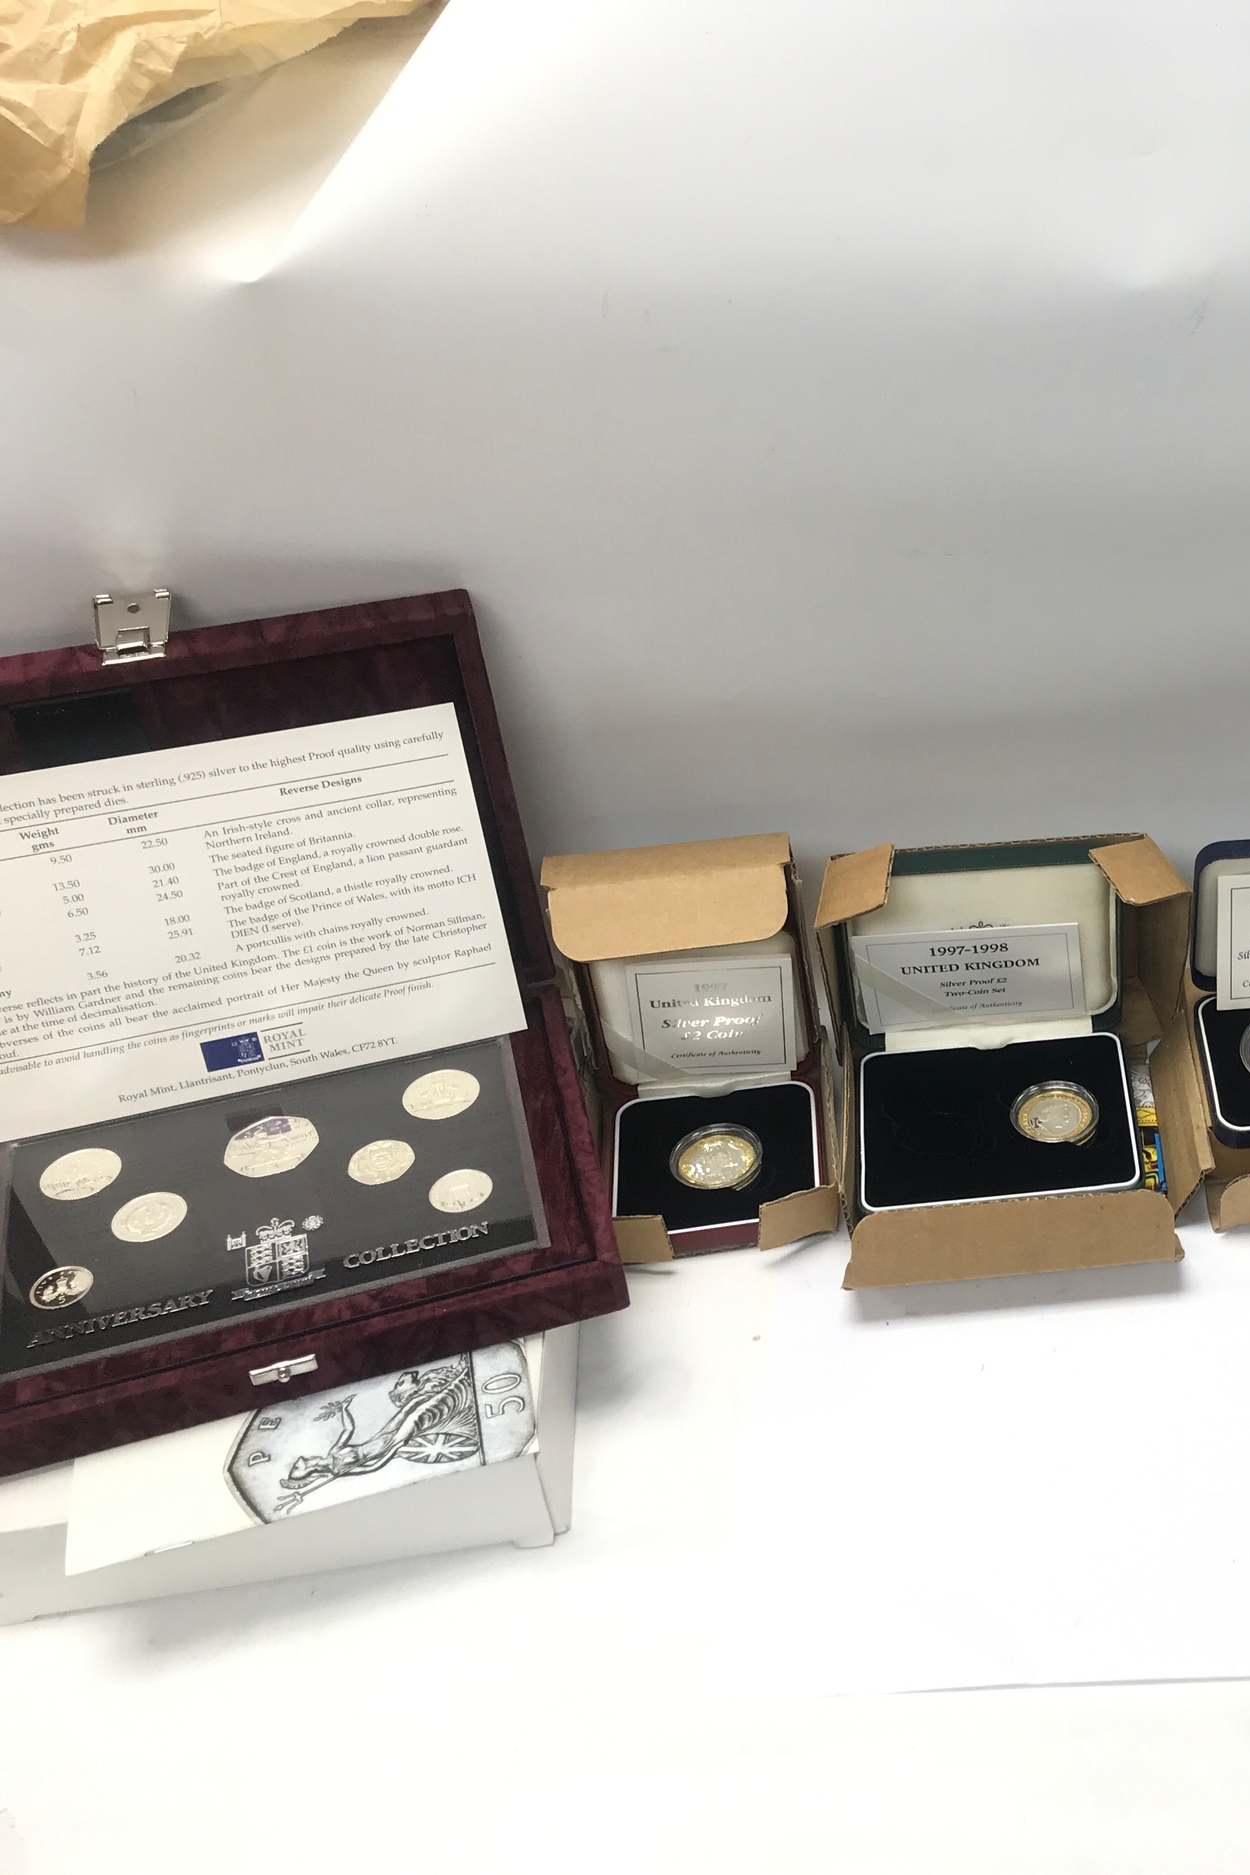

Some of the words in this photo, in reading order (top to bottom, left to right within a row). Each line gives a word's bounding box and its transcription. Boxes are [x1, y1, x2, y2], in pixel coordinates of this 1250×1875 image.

[37, 797, 58, 806] has
[57, 792, 86, 803] been
[86, 784, 121, 798] struck
[122, 783, 134, 792] in
[135, 777, 177, 790] sterling
[177, 770, 206, 784] (.925)
[208, 767, 237, 778] silver
[238, 765, 250, 773] to
[251, 761, 268, 771] the
[269, 754, 307, 768] highest
[307, 748, 335, 761] Proof
[337, 744, 372, 758] quality
[373, 739, 402, 750] using
[402, 730, 444, 745] carefully
[278, 783, 320, 797] Reverse
[320, 776, 363, 789] Designs
[3, 808, 51, 826] specially
[52, 799, 102, 819] prepared
[103, 797, 129, 807] dies.
[107, 811, 159, 826] Diameter
[203, 829, 219, 839] An
[221, 819, 273, 836] Irish-style
[275, 815, 302, 826] cross
[304, 809, 324, 821] and
[327, 803, 363, 817] ancient
[365, 798, 395, 810] collar,
[397, 787, 458, 805] representing
[18, 827, 60, 841] Weight
[125, 825, 148, 835] mm
[140, 837, 169, 850] 22.50
[204, 835, 253, 850] Northern
[254, 826, 293, 841] Ireland.
[30, 841, 56, 854] gms
[208, 853, 230, 864] The
[231, 846, 263, 860] seated
[264, 842, 295, 855] figure
[296, 837, 307, 848] of
[308, 831, 356, 846] Britannia.
[49, 853, 73, 865] 9.50
[148, 862, 176, 875] 30.00
[52, 879, 81, 892] 13.50
[152, 875, 180, 889] 21.40
[156, 889, 184, 902] 24.50
[220, 888, 255, 903] royally
[257, 878, 303, 895] crowned.
[62, 893, 85, 905] 5.00
[67, 906, 89, 919] 6.50
[164, 913, 191, 926] 18.00
[167, 927, 194, 940] 25.91
[230, 925, 259, 939] DIEN
[261, 924, 270, 934] (I
[269, 918, 304, 932] serve).
[235, 943, 244, 953] A
[245, 934, 293, 953] portcullis
[293, 929, 317, 941] with
[318, 924, 350, 936] chains
[350, 916, 384, 931] royally
[385, 907, 429, 923] crowned.
[74, 931, 97, 944] 3.25
[78, 945, 102, 957] 7.12
[929, 943, 1009, 957] 1997-1998
[174, 951, 202, 964] 20.32
[4, 1016, 14, 1024] is
[15, 1013, 30, 1023] by
[32, 1005, 76, 1018] William
[77, 995, 122, 1010] Gardner
[125, 988, 145, 1001] and
[148, 984, 165, 996] the
[167, 976, 220, 992] remaining
[221, 970, 249, 981] coins
[250, 965, 273, 976] bear
[275, 961, 292, 971] the
[294, 954, 331, 967] designs
[333, 943, 377, 962] prepared
[378, 941, 392, 952] by
[394, 938, 410, 947] the
[411, 934, 430, 944] late
[432, 922, 488, 940] Christopher
[901, 963, 960, 976] UNITED
[964, 958, 1040, 971] KINGDOM
[86, 969, 109, 981] 3.56
[940, 979, 967, 988] Silver
[969, 977, 995, 986] Proof
[944, 988, 989, 998] Two-Coin
[703, 994, 772, 1007] Kingdom
[969, 1002, 978, 1010] of
[979, 1000, 1023, 1009] Authenticity
[661, 1018, 710, 1029] Silver
[713, 1014, 763, 1027] Proof
[263, 1029, 306, 1044] ROYAL
[682, 1030, 702, 1041] £2
[706, 1029, 744, 1040] Coin
[270, 1038, 305, 1053] MINT
[117, 1089, 149, 1103] Royal
[149, 1084, 178, 1096] Mint,
[178, 1072, 236, 1090] Llantrisant,
[236, 1062, 289, 1078] Pontyclun,
[289, 1053, 319, 1067] South
[319, 1048, 351, 1060] Wales,
[351, 1041, 377, 1053] CF72
[376, 1036, 399, 1048] 8YT.
[342, 1220, 490, 1270] COLLECTION
[26, 1289, 214, 1349] ANNIVERSARY
[480, 1371, 526, 1420] 50
